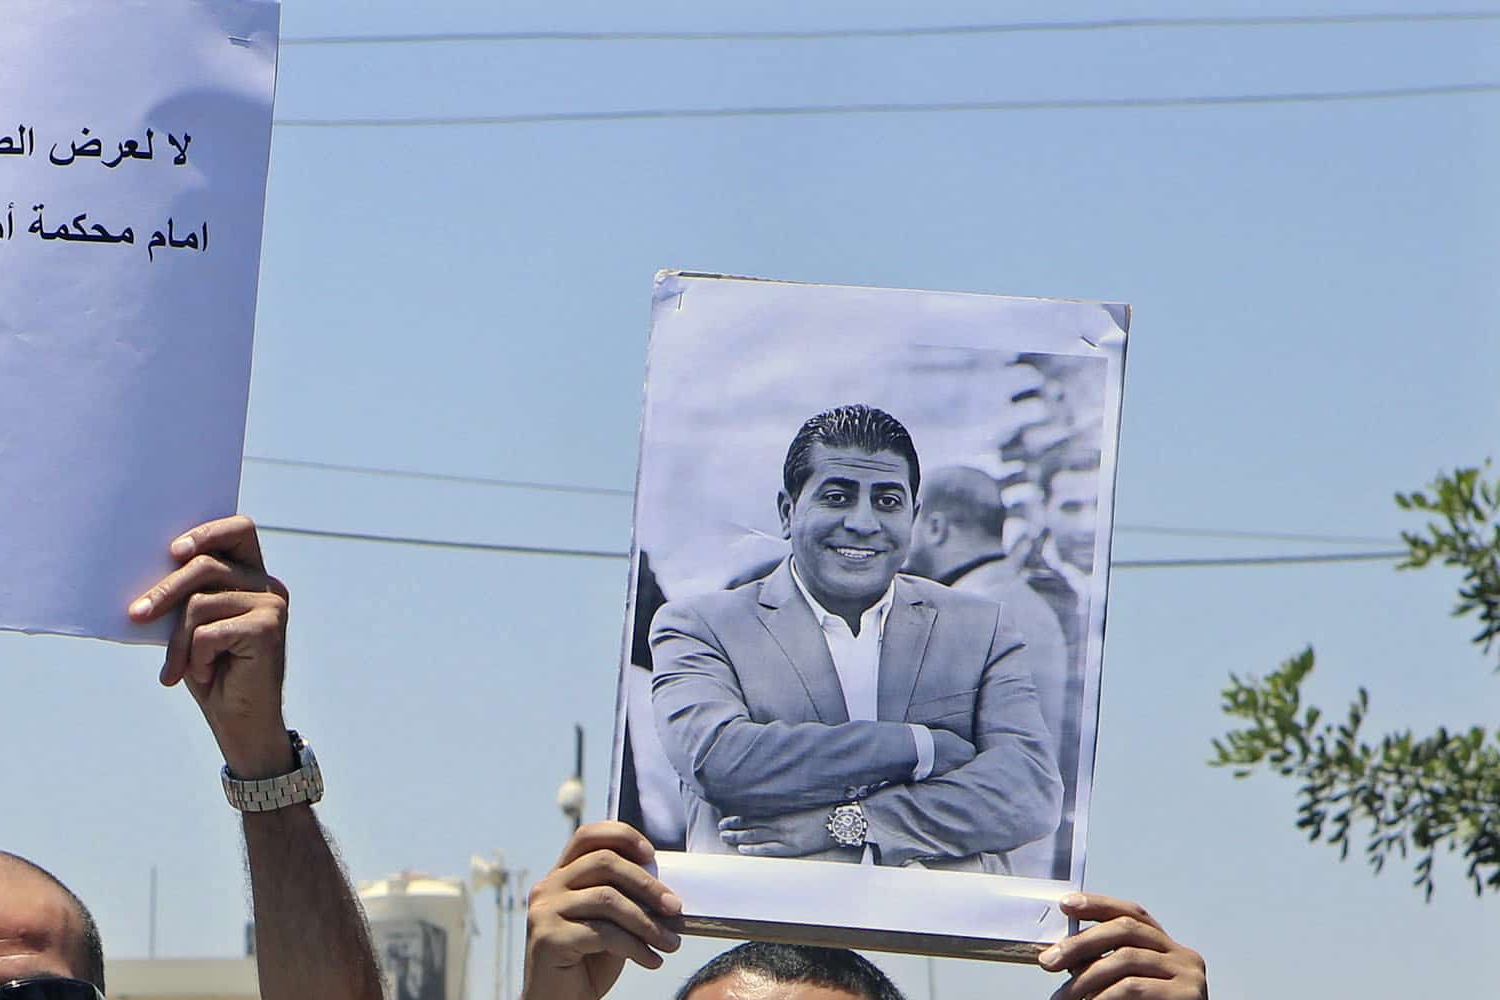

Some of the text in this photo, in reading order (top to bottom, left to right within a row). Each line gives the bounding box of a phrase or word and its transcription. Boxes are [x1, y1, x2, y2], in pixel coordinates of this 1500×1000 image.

[49, 127, 154, 169] لعرض
[168, 132, 192, 166] لا
[28, 203, 135, 245] محكمة
[147, 217, 208, 262] امام
